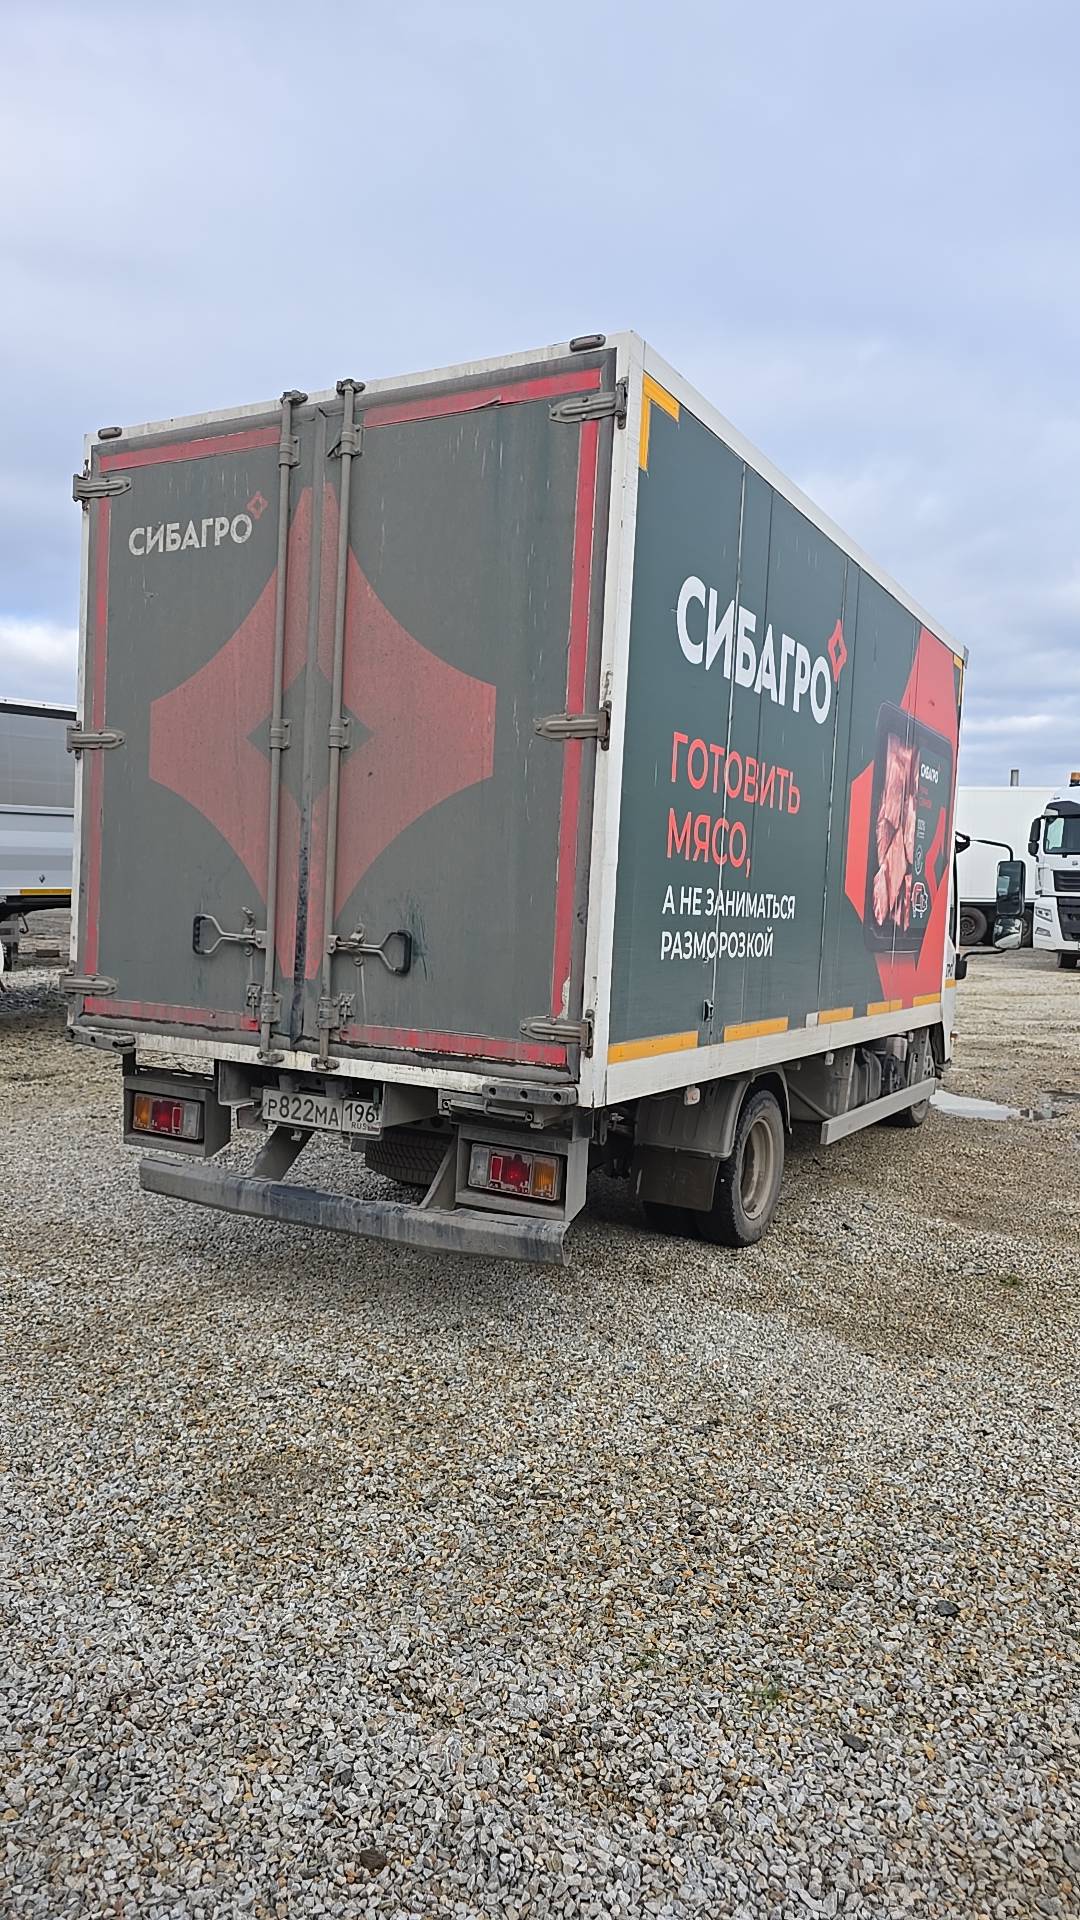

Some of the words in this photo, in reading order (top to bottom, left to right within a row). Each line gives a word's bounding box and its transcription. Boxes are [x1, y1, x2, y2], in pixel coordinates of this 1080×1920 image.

[128, 513, 253, 556] СИБАГРО
[676, 575, 832, 725] СИБАГРО
[671, 731, 801, 815] ГОТОВИТЬ
[666, 808, 751, 879] МЯСО,
[661, 884, 676, 915] А
[680, 886, 703, 916] НЕ
[704, 887, 796, 920] ЗАНИМАТЬСЯ
[660, 926, 775, 961] РАЗМОРОЗКОЙ
[267, 1095, 340, 1127] Р822МА
[344, 1102, 376, 1123] 196
[351, 1121, 368, 1131] RUS
